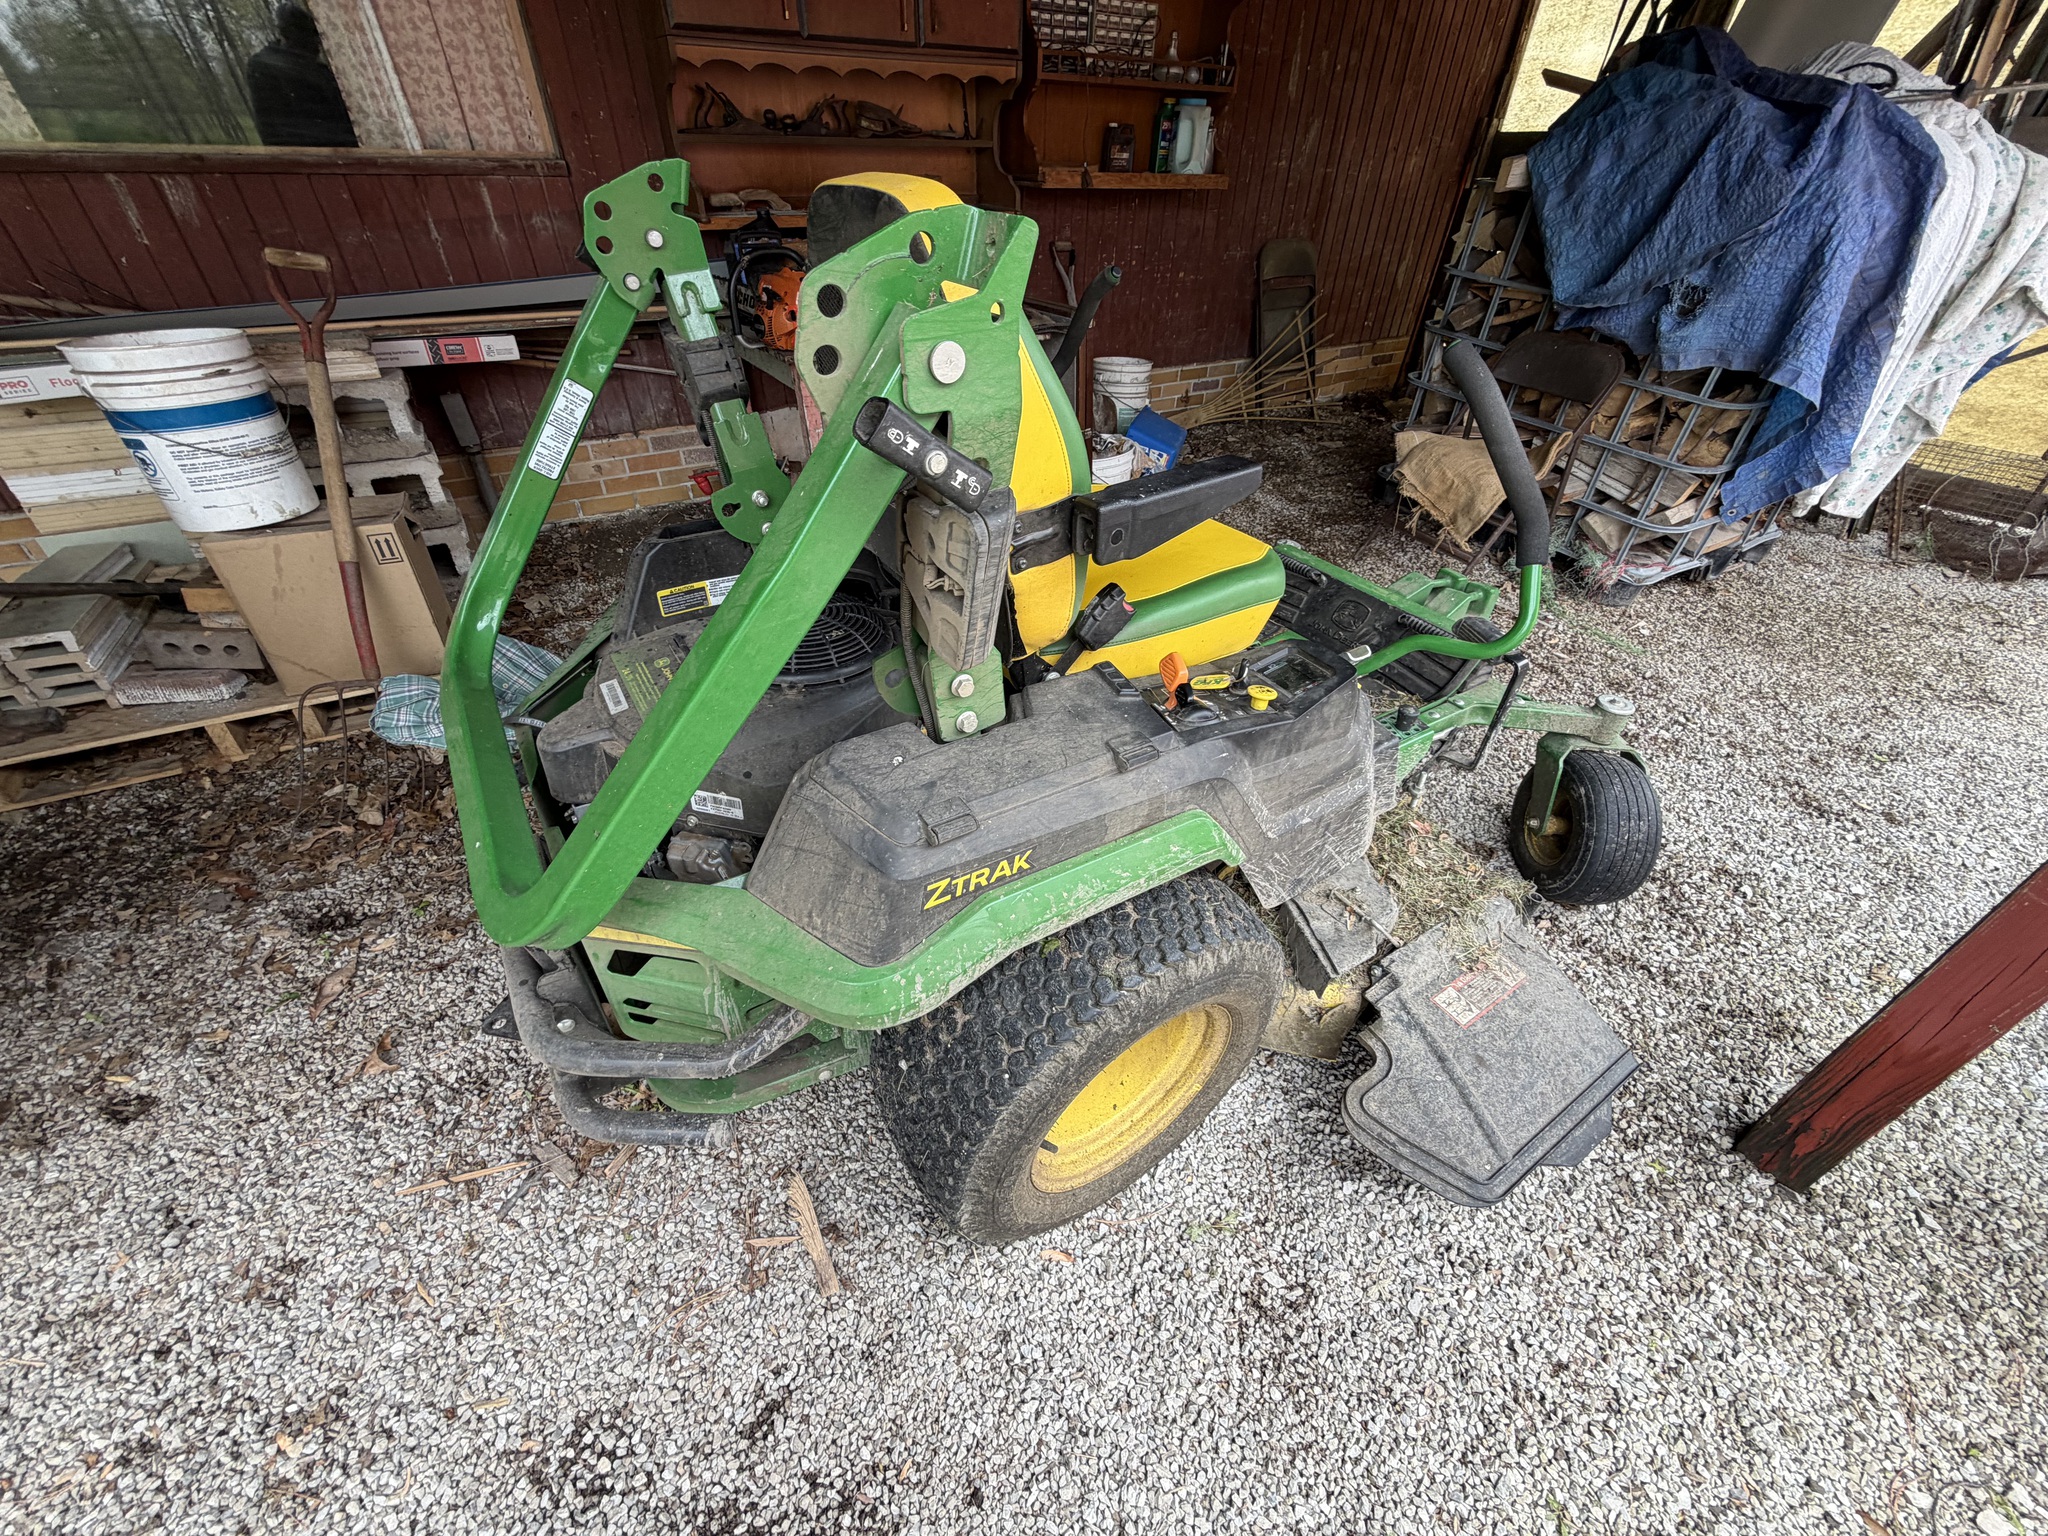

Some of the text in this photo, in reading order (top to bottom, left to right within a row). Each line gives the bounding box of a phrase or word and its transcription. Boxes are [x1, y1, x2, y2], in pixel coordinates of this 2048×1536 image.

[0, 380, 28, 391] PRO
[48, 377, 80, 388] Floo
[673, 585, 695, 593] CAUTION
[1332, 630, 1360, 649] DEER
[923, 849, 1033, 910] ZTRAK
